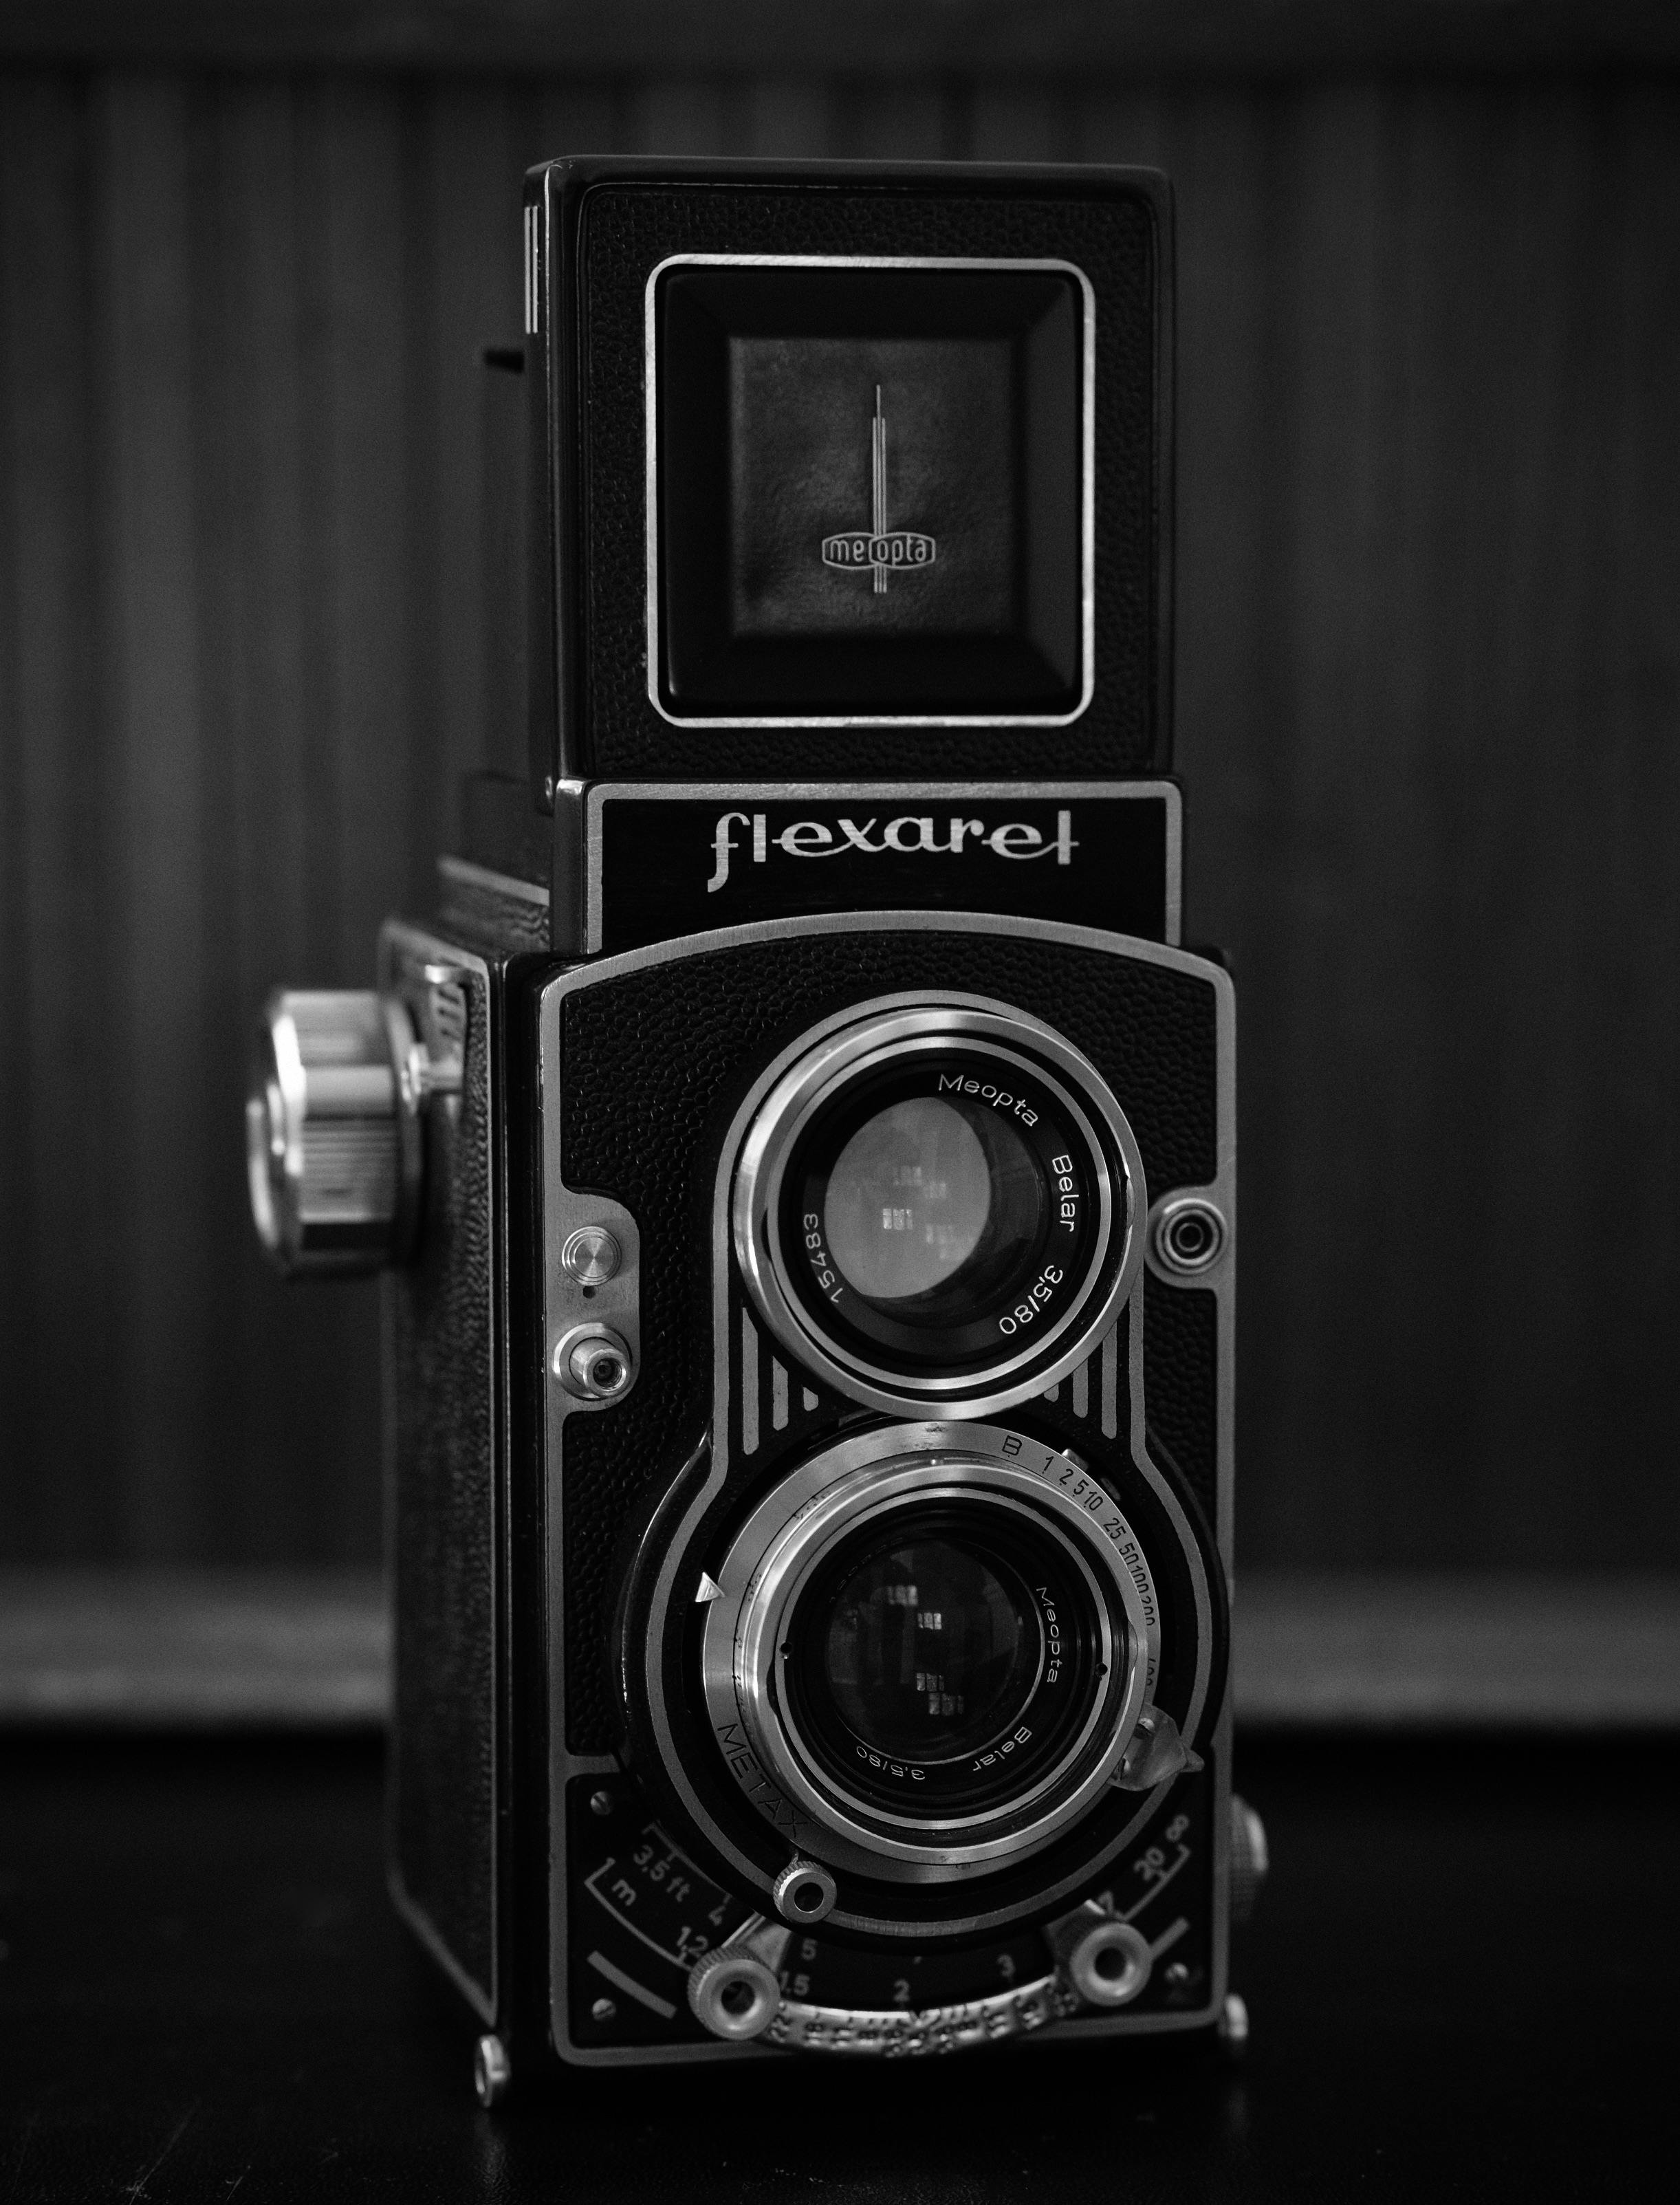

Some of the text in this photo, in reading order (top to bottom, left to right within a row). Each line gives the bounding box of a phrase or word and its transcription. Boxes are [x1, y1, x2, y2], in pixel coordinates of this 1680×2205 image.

[829, 535, 928, 567] meopta
[707, 810, 1080, 893] flexaret
[938, 1073, 1039, 1127] Meopta
[1051, 1154, 1080, 1232] Belar
[803, 1213, 844, 1303] 15483
[1002, 1435, 1023, 1456] B
[1043, 1455, 1055, 1473] 1
[1059, 1468, 1074, 1486] 2
[1073, 1479, 1089, 1495] 5
[1084, 1490, 1104, 1512] 10
[1102, 1517, 1126, 1539] 25
[1118, 1542, 1140, 1567] 50
[1036, 1586, 1064, 1684] Meopta
[717, 1723, 808, 1838] METAX
[972, 1726, 1033, 1772] Belar
[611, 1878, 637, 1907] m
[894, 1978, 911, 2003] 2
[995, 1953, 1016, 1979] 3
[1133, 1845, 1166, 1882] 20
[666, 1876, 690, 1902] ft
[800, 1937, 820, 1962] 5
